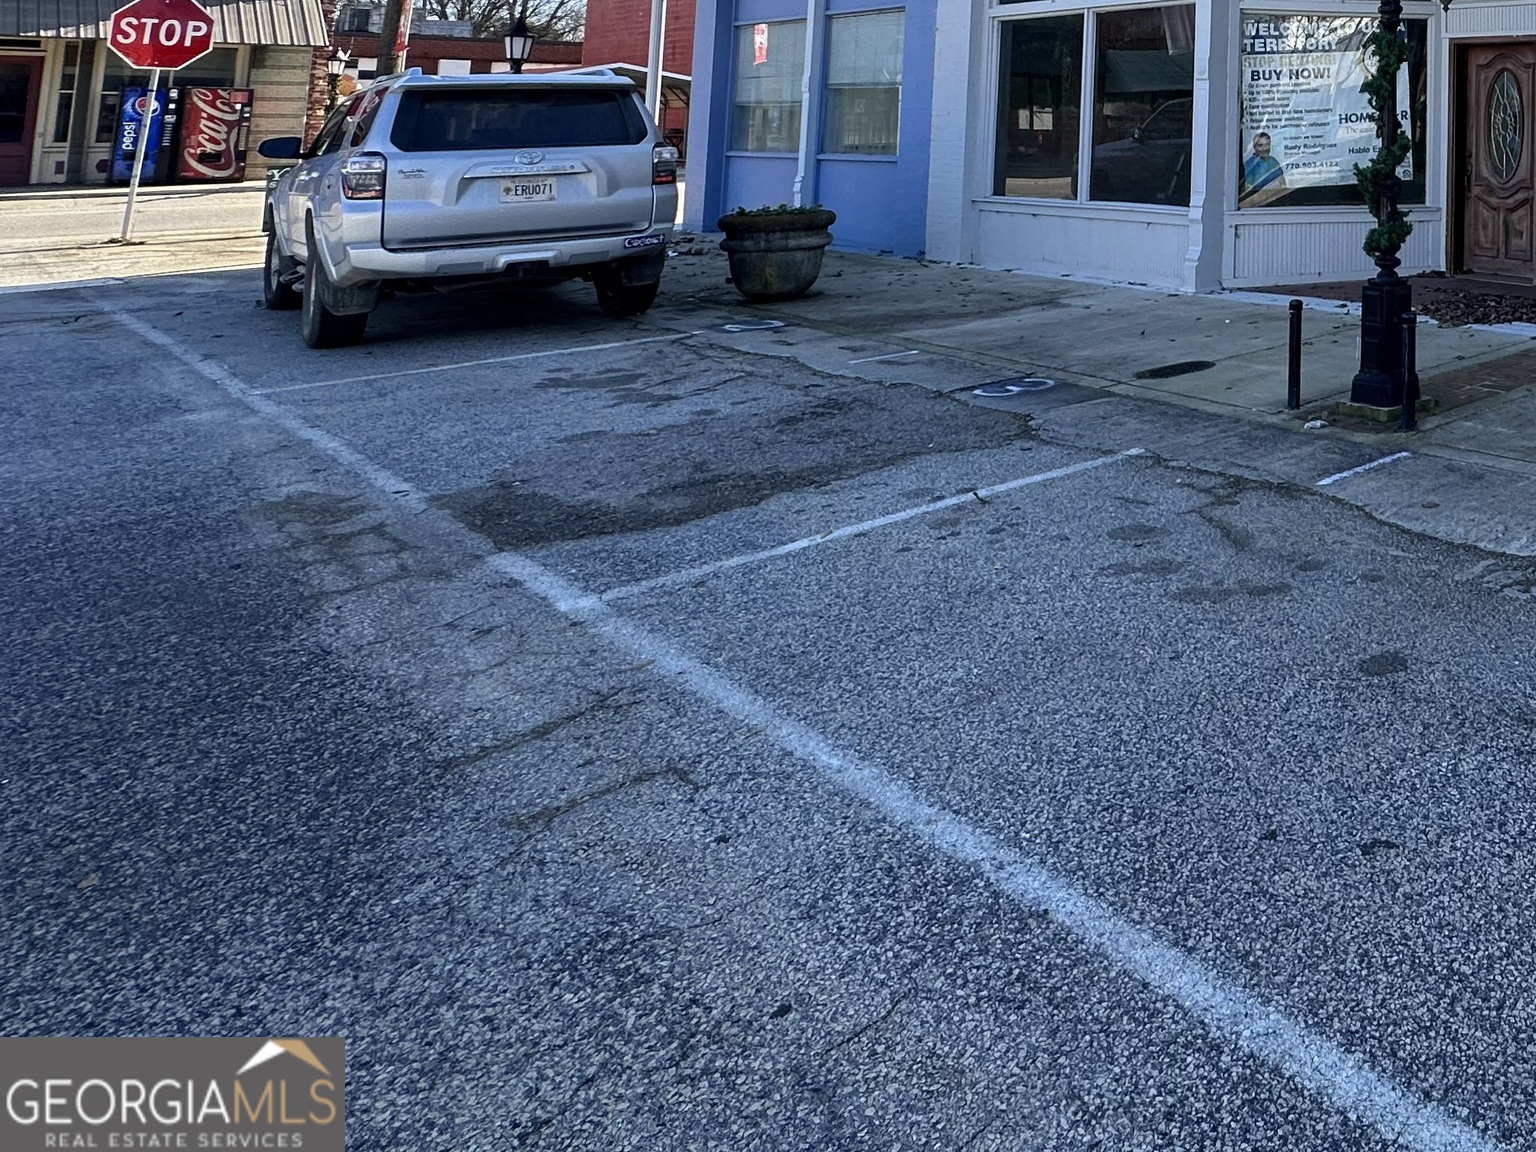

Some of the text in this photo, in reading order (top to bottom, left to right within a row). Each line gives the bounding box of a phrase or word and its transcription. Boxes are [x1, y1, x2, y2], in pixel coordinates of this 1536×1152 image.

[116, 16, 208, 47] STOP
[1244, 56, 1275, 68] STOP
[1251, 67, 1331, 82] BUY NOW!
[514, 184, 552, 196] ERU071
